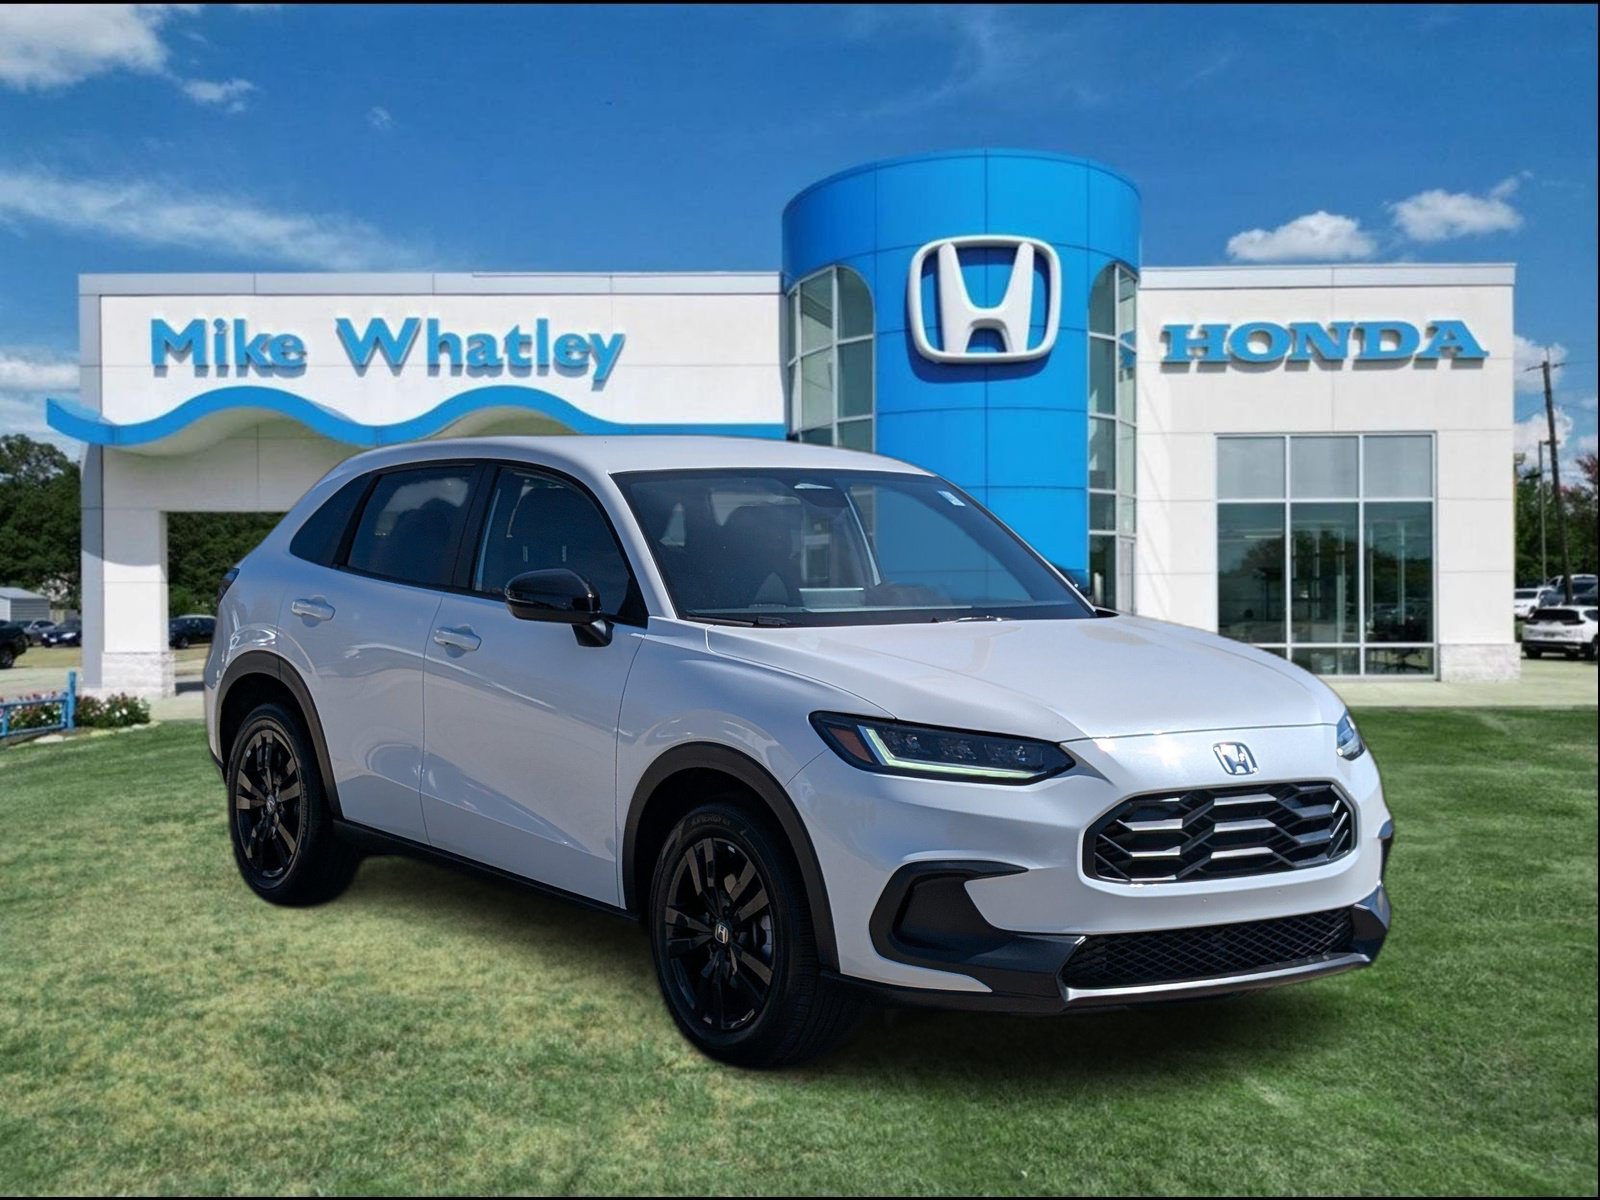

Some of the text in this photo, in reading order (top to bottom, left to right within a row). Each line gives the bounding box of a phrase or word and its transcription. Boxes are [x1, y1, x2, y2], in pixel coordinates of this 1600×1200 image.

[150, 317, 625, 384] Mike Whatley
[1161, 320, 1490, 364] HONDA
